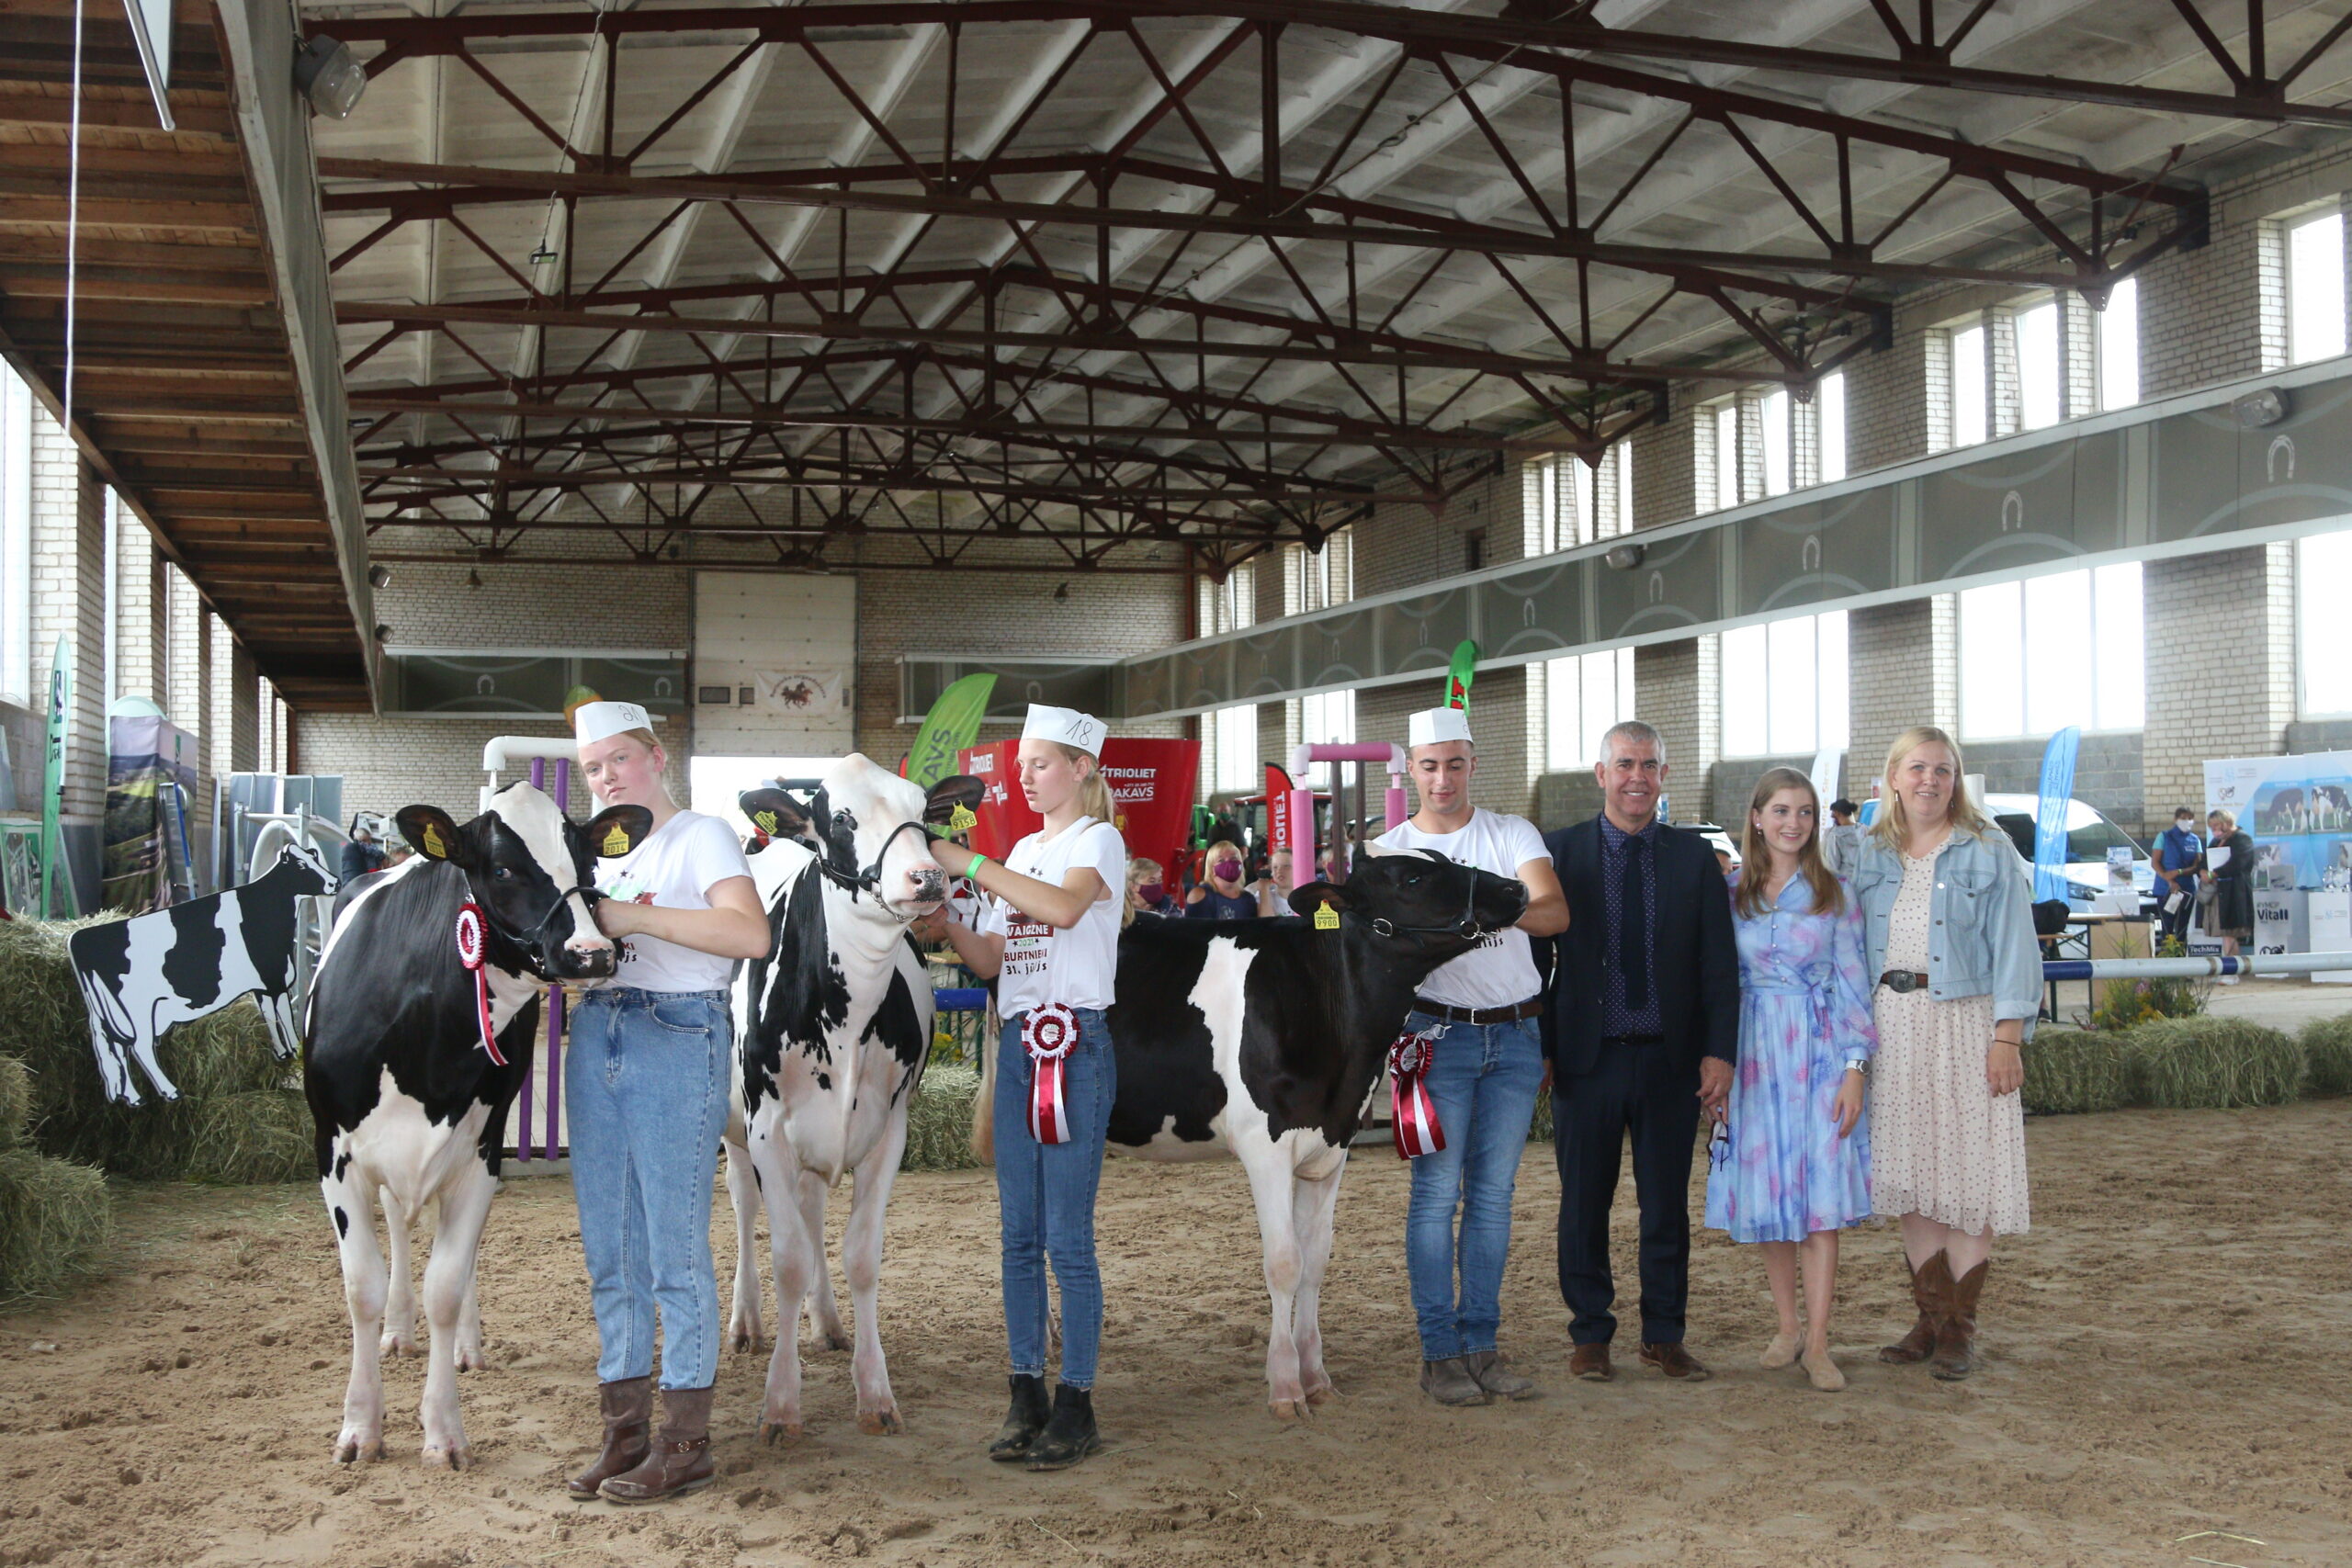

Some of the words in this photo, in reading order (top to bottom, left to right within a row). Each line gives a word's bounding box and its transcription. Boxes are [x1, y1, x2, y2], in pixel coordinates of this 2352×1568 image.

[1066, 719, 1092, 746] 18
[1106, 768, 1156, 778] TRIOLIET
[953, 818, 976, 829] 9158
[605, 844, 627, 855] 2014
[2257, 908, 2289, 920] Vitall
[1317, 919, 1338, 928] 9900
[1018, 939, 1035, 947] 2021
[2190, 945, 2220, 953] TechMix
[1006, 964, 1021, 976] 31.
